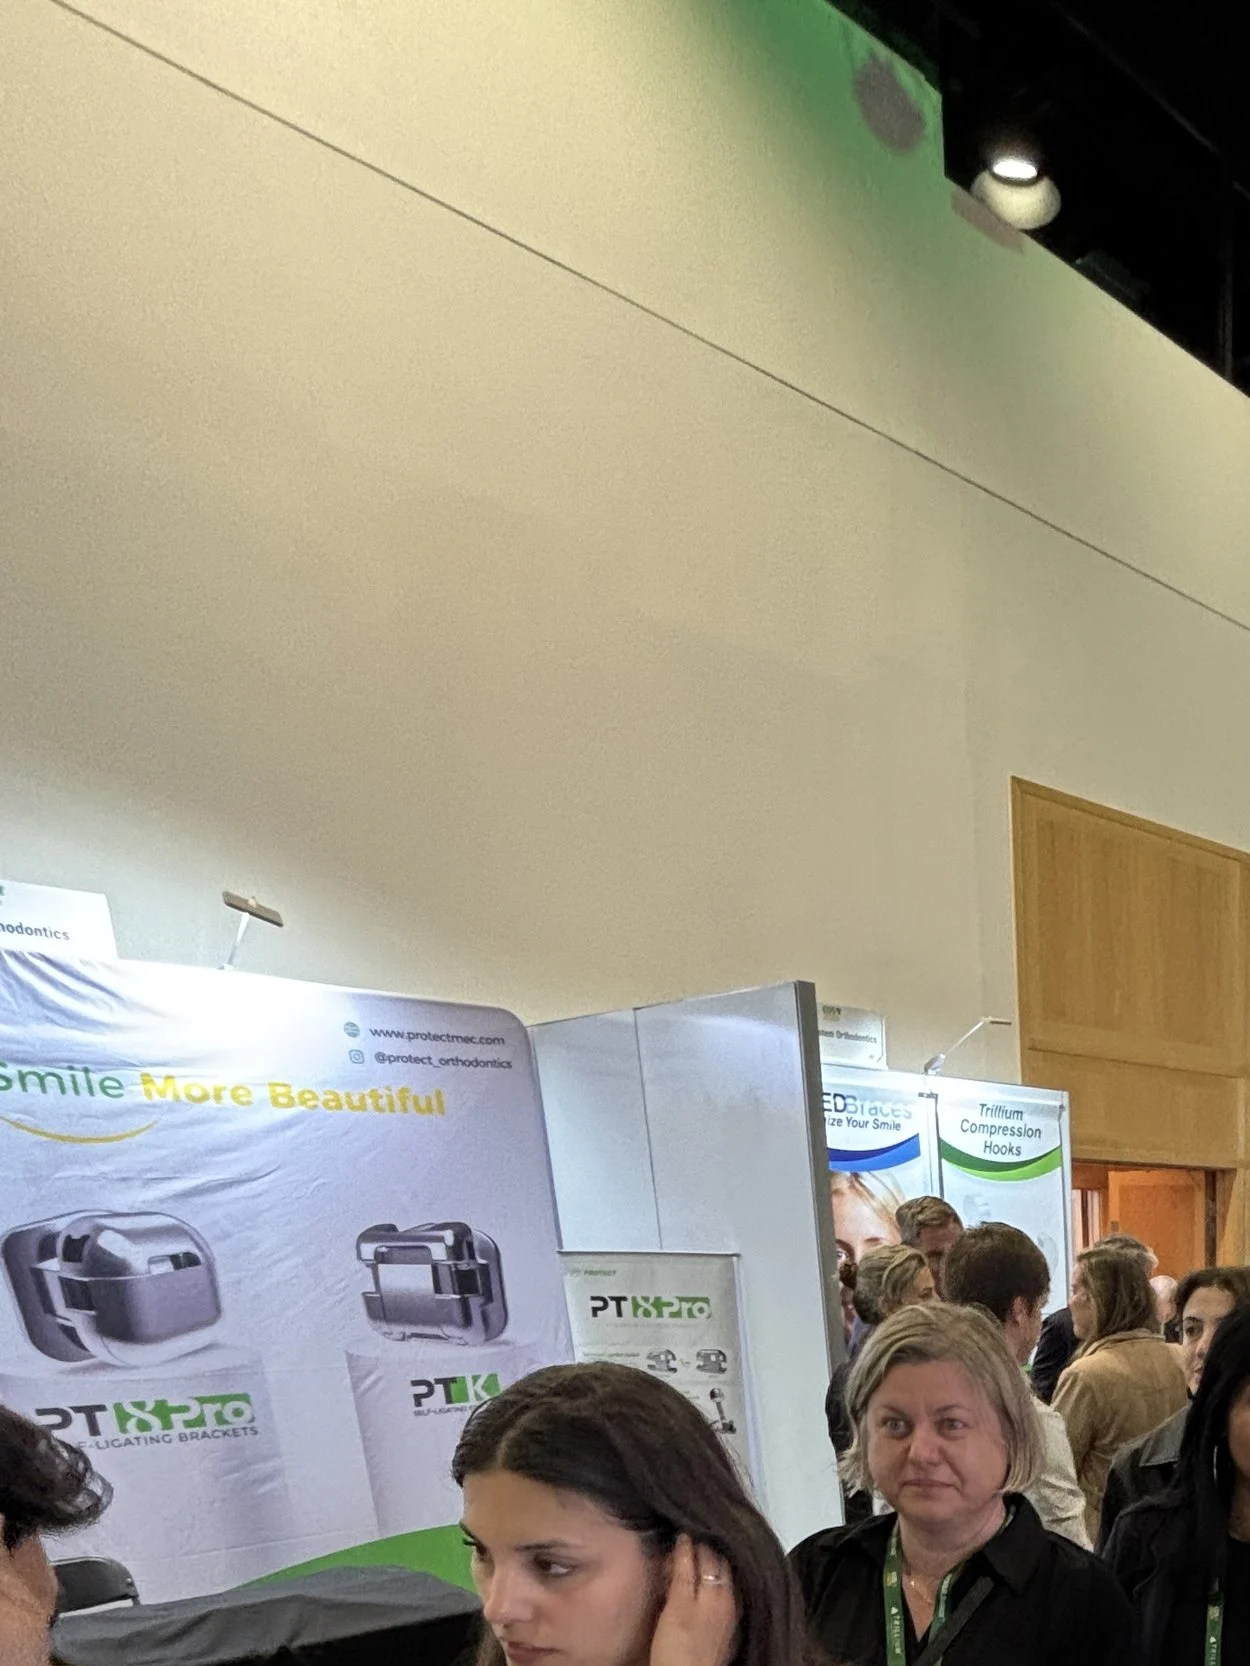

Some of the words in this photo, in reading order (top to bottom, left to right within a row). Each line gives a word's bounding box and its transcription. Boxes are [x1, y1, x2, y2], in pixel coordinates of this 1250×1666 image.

[374, 1051, 512, 1069] @protect_orthodontics
[0, 1061, 125, 1098] Smile
[139, 1071, 253, 1107] More
[267, 1081, 446, 1117] Beautiful
[979, 1103, 1024, 1121] Trillium
[846, 1116, 869, 1128] Your
[872, 1118, 901, 1131] Smile
[960, 1119, 1041, 1139] Compression
[984, 1140, 1022, 1156] Hooks
[178, 1426, 259, 1443] BRACKETS
